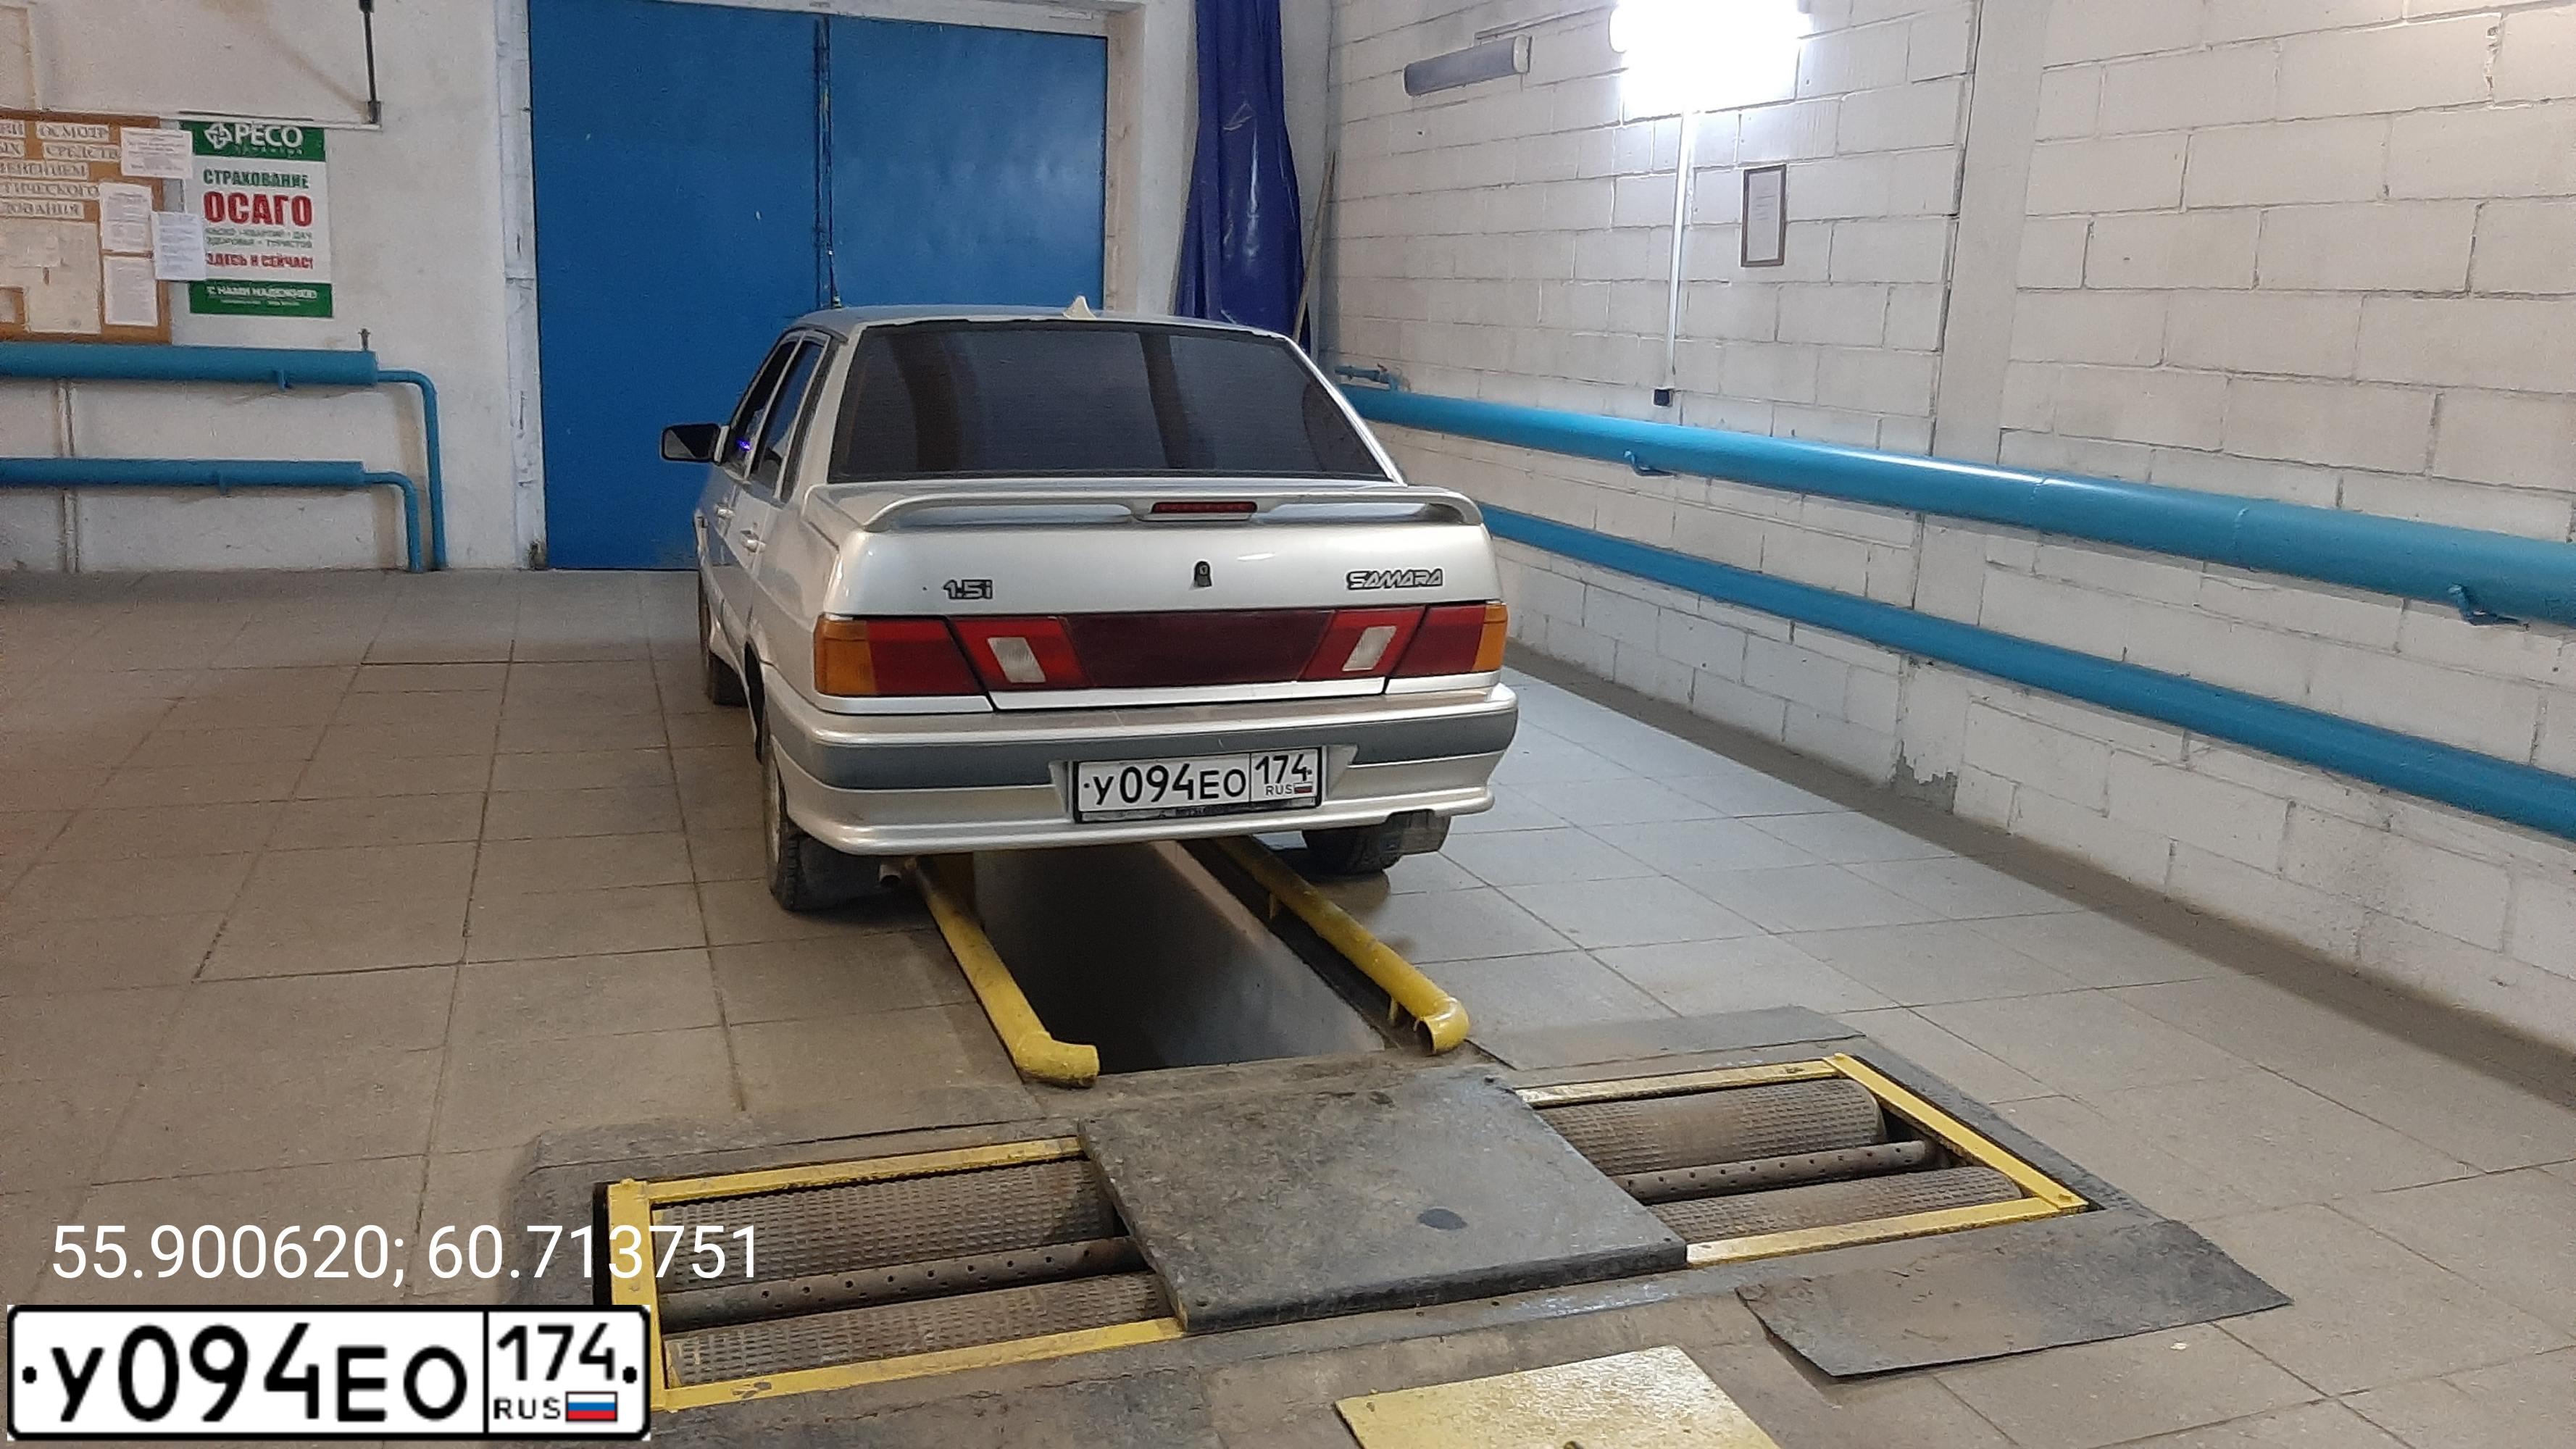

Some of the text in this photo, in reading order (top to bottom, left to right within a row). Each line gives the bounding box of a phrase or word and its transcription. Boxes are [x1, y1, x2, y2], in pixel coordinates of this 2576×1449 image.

[234, 123, 304, 148] РЕСО
[203, 170, 309, 189] СТРАХОВАНИЕ
[203, 191, 313, 227] ОСАГО
[206, 253, 248, 267] ЗДЕСЬ
[251, 254, 259, 267] И
[943, 579, 993, 600] 1.5i
[1346, 568, 1443, 590] SAMARA
[1093, 753, 1309, 806] У094ЕО 174
[1265, 784, 1293, 796] RUS
